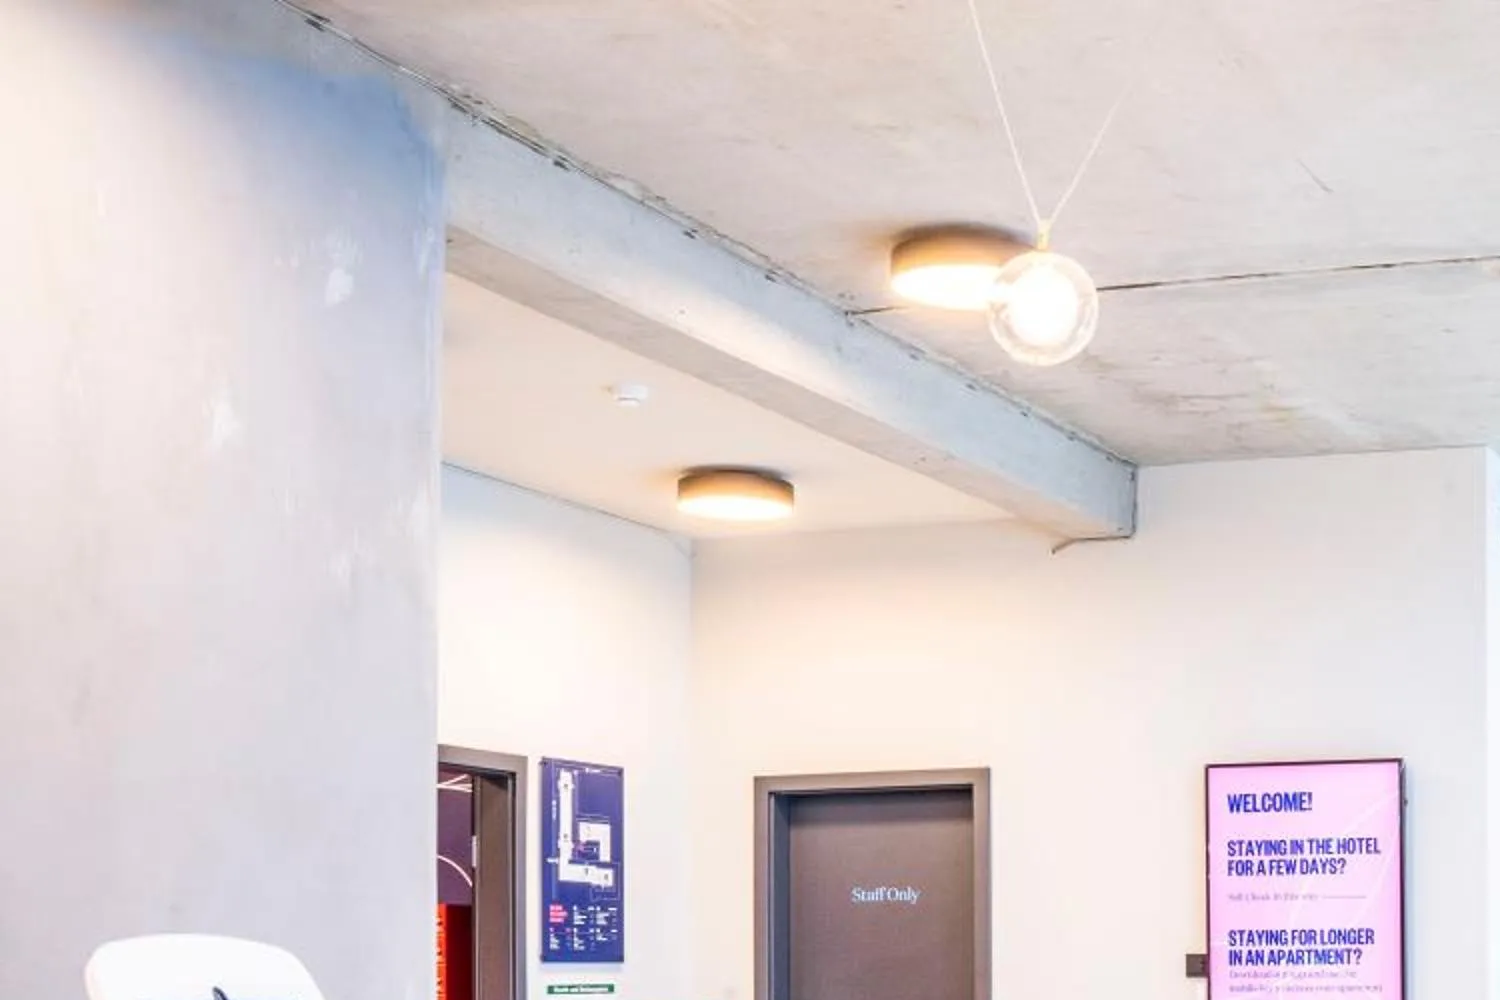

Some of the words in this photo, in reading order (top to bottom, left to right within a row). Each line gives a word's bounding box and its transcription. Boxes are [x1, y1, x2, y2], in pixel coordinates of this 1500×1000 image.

[1227, 791, 1313, 813] WELCOME!
[1227, 839, 1287, 857] STAYING
[1289, 839, 1305, 856] IN
[1306, 838, 1335, 855] THE
[1336, 837, 1381, 854] HOTEL
[1227, 859, 1254, 876] FOR
[1256, 860, 1267, 876] A
[1268, 859, 1298, 876] FEW
[1299, 857, 1347, 875] DAYS?
[851, 886, 887, 902] Staff
[887, 886, 921, 905] Only
[1228, 929, 1288, 947] STAYING
[1291, 929, 1317, 946] FOR
[1320, 928, 1375, 945] LONGER
[1228, 950, 1243, 966] IN
[1245, 950, 1265, 966] AN
[1267, 949, 1363, 966] APARTMENT?
